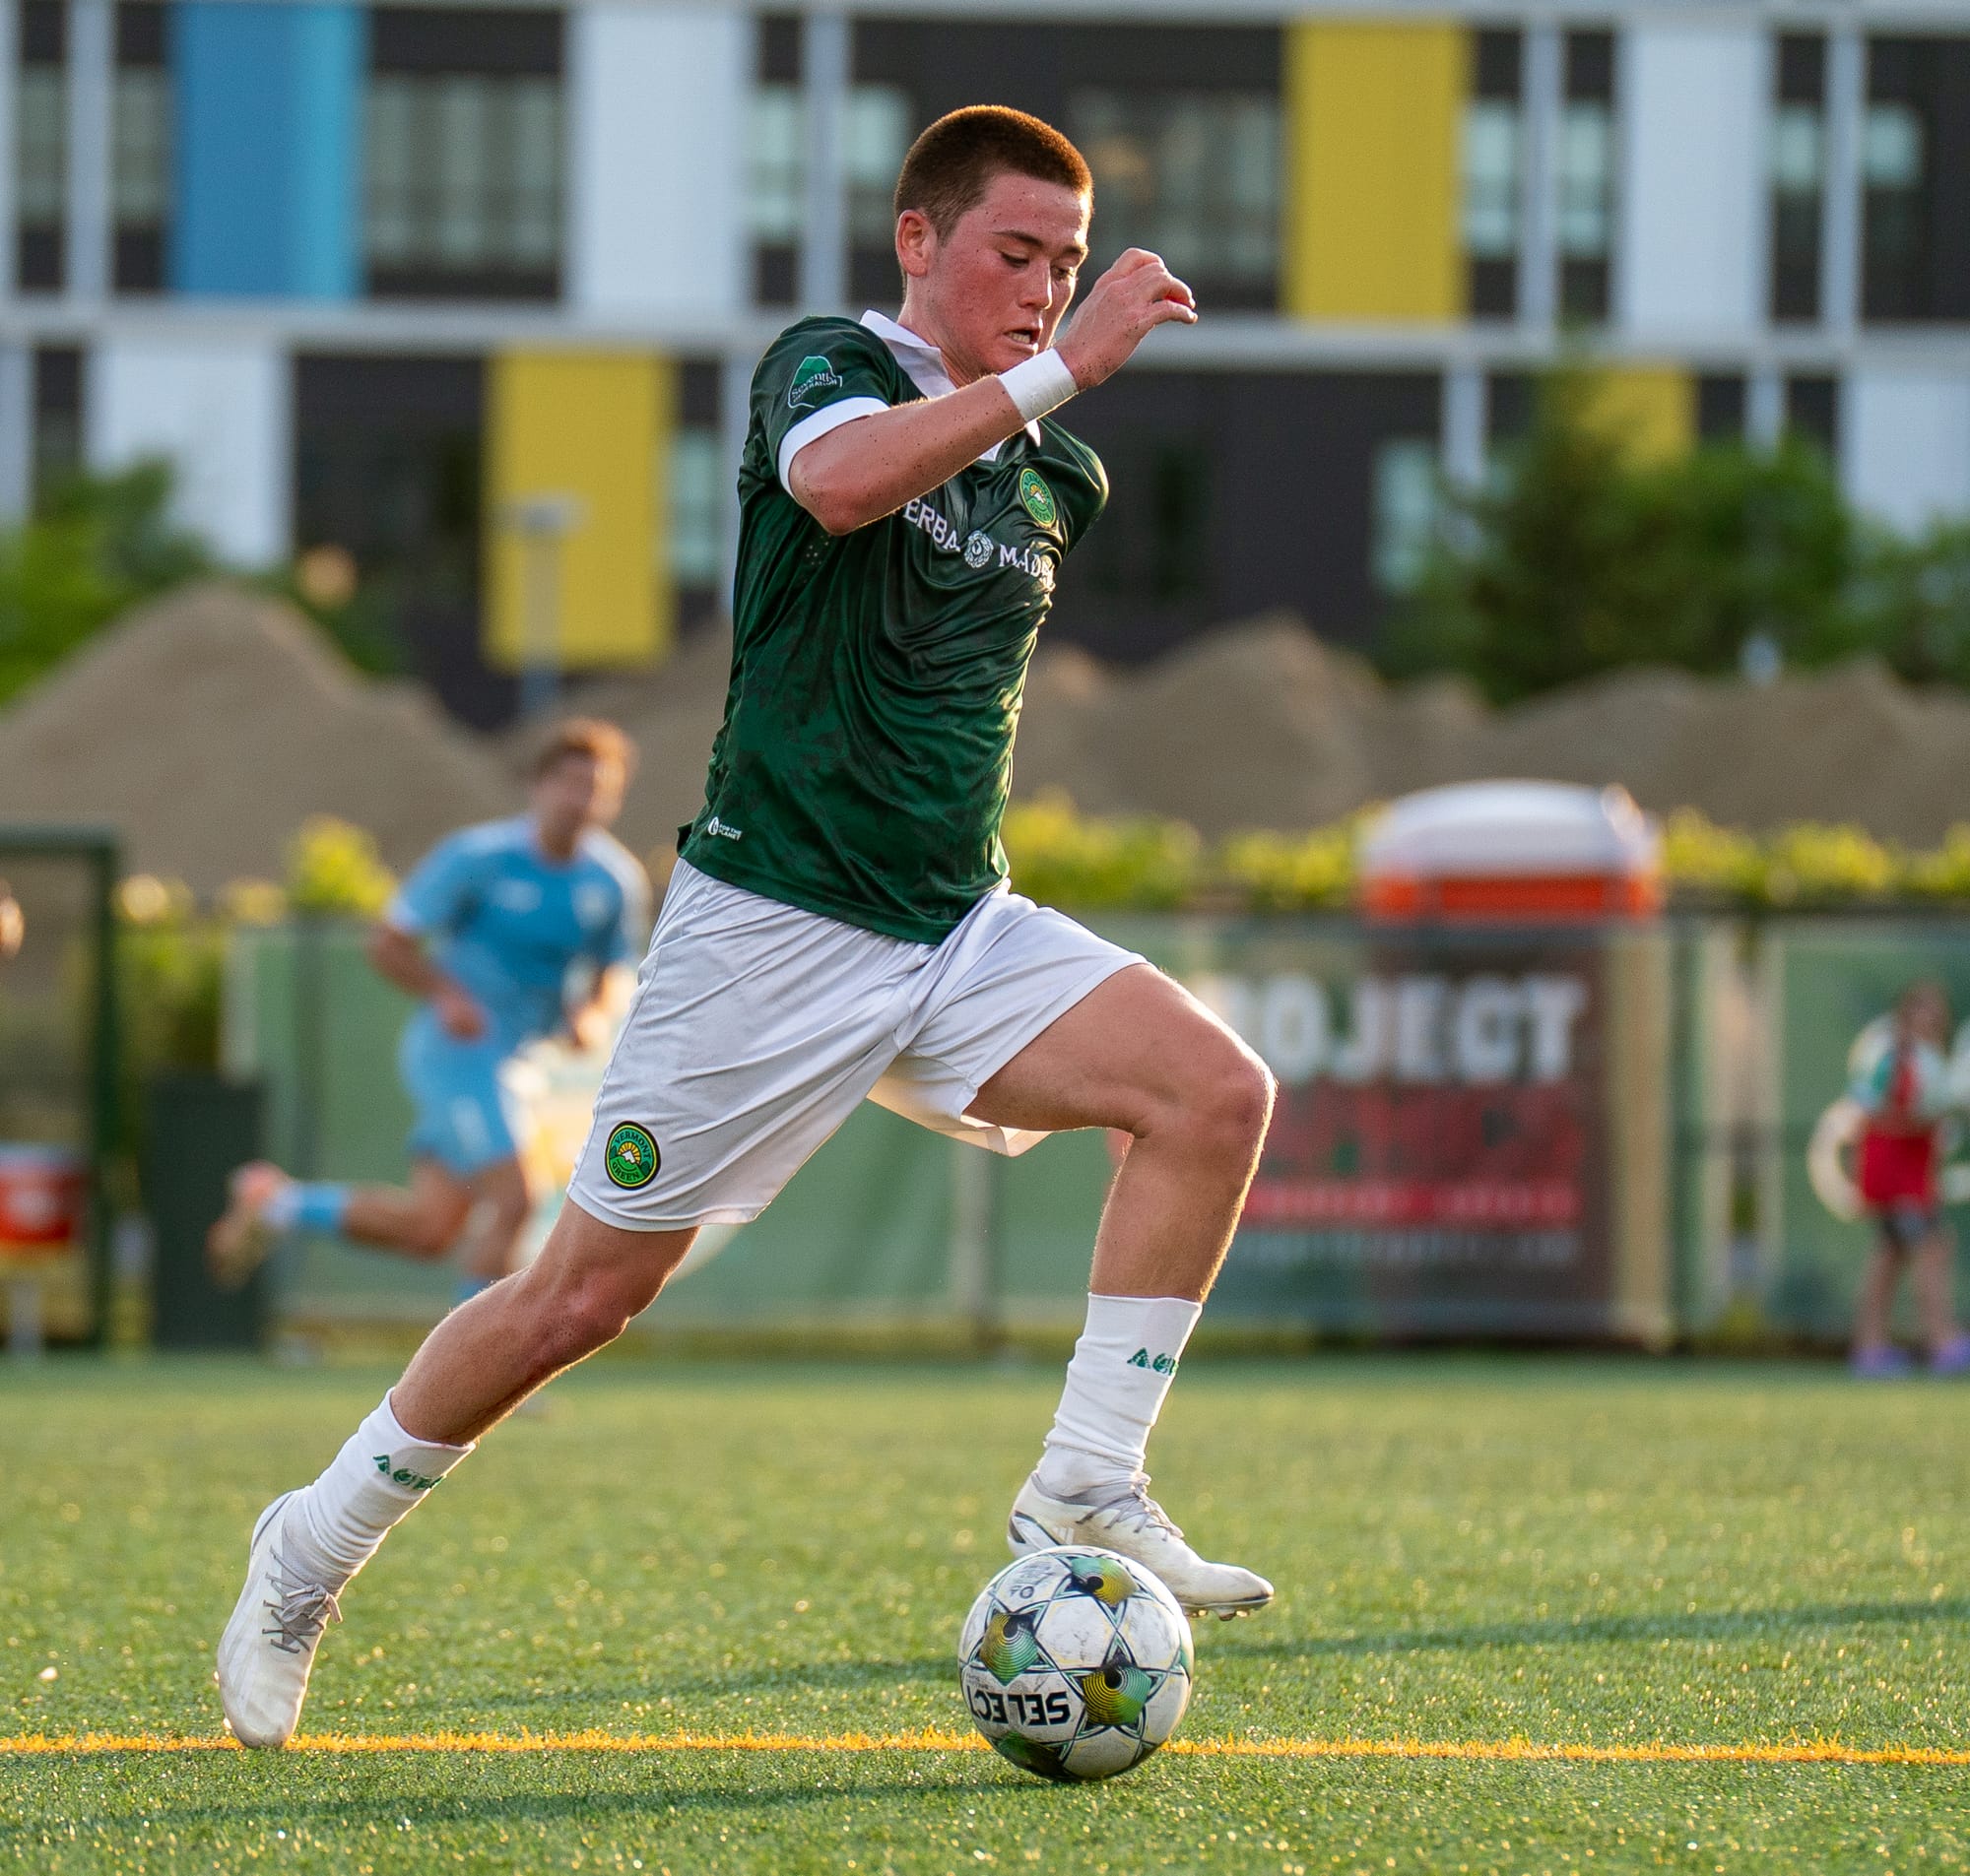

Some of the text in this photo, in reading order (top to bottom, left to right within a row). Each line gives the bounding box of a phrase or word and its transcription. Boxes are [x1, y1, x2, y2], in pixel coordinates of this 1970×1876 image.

[892, 497, 960, 551] ERBA
[1194, 971, 1588, 1083] OJECT
[614, 1131, 652, 1159] VERMONT
[612, 1162, 640, 1181] GREEN
